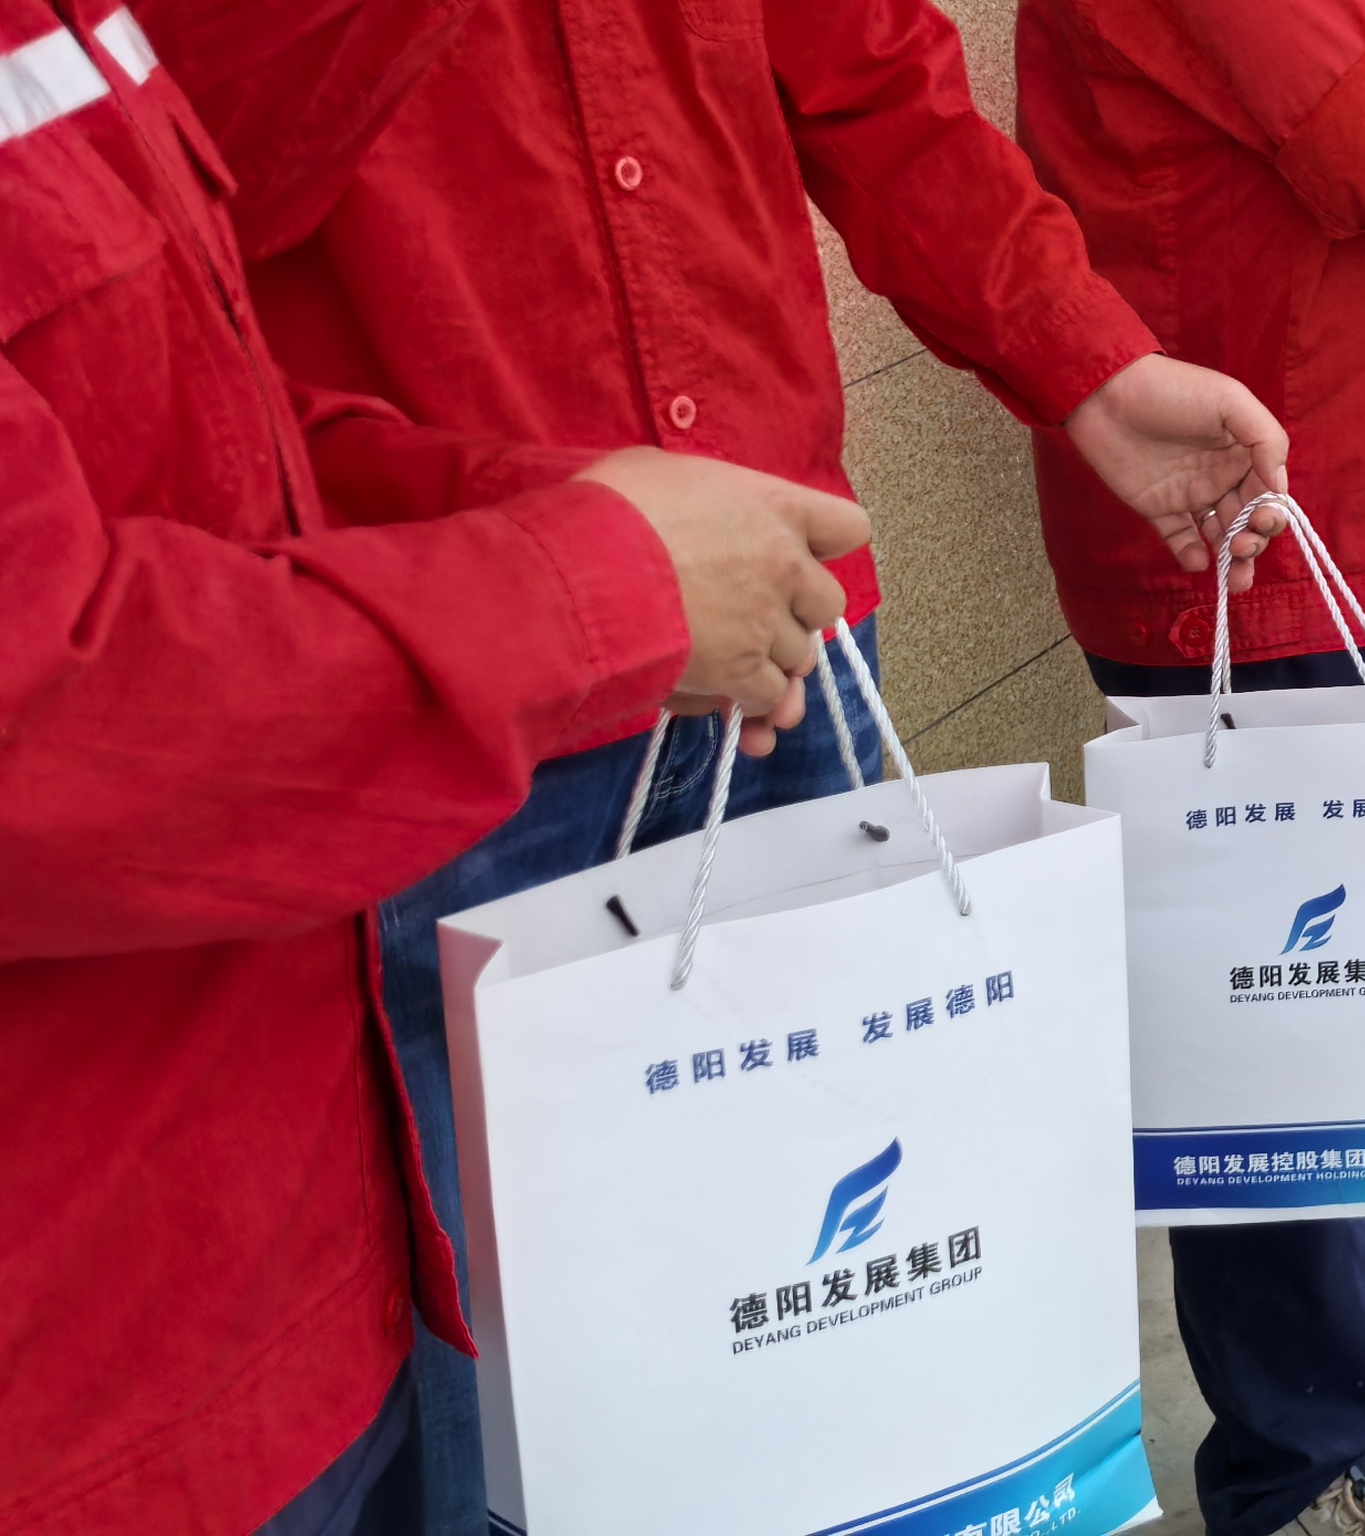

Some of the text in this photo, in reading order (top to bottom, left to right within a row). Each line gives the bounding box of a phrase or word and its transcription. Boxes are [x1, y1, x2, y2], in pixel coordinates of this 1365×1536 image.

[1186, 802, 1296, 830] 德阳发展
[1229, 992, 1275, 1004] DEYANG
[1277, 987, 1356, 1001] DEVELOPMENT
[645, 970, 1015, 1095] 德阳发展 发展德阳
[1176, 1177, 1225, 1186] DEYANG
[1227, 1172, 1312, 1185] DEVELOPMENT
[729, 1225, 983, 1334] 德阳发展集团
[732, 1266, 983, 1355] DEYANG DEVELOPMENT GROUP
